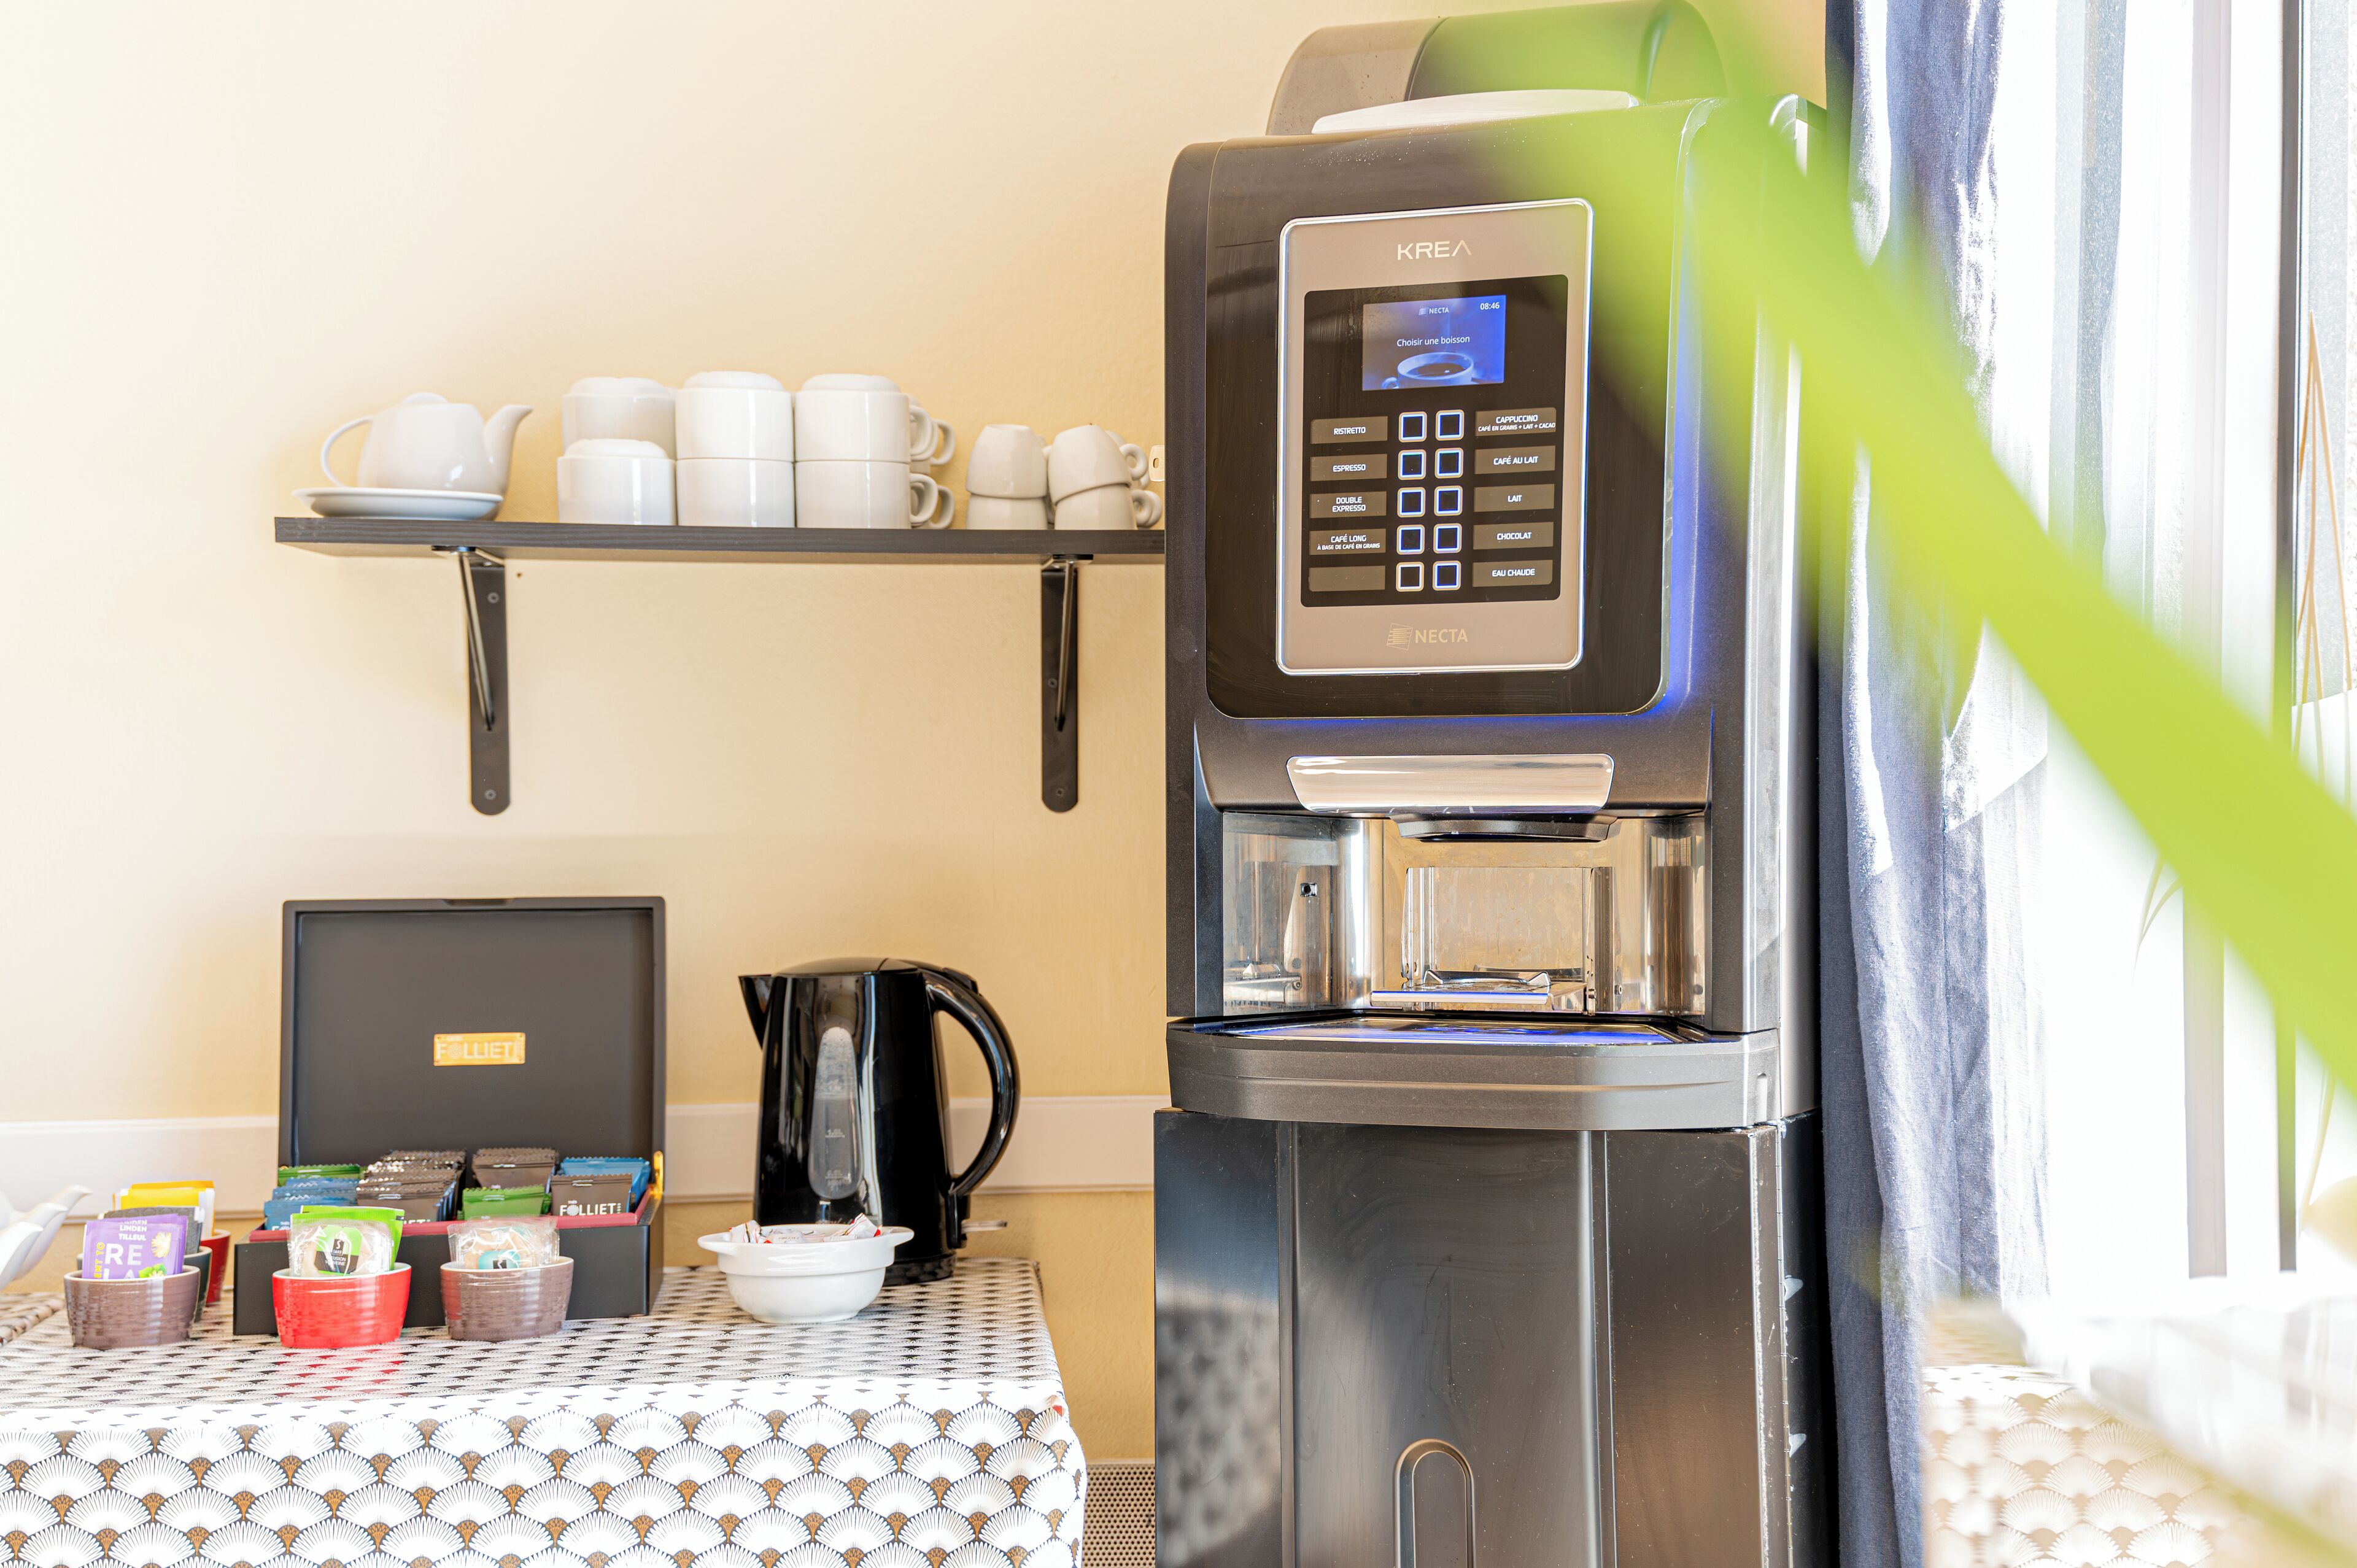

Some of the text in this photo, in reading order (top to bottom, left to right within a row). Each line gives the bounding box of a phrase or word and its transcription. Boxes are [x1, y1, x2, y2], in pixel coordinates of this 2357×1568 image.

[1397, 239, 1473, 261] KREA
[1480, 302, 1500, 311] 08:46
[1397, 338, 1423, 347] Choisir
[1496, 414, 1538, 424] CAPPUCCINO
[1333, 427, 1366, 435] RISTRETTO
[1493, 455, 1511, 465] CAFÉ
[1333, 464, 1366, 473] ESPRESSO
[1336, 496, 1362, 504] DOUBLE
[1332, 504, 1366, 512] EXPRESSO
[1331, 533, 1347, 543] CAFÉ
[1496, 531, 1532, 540] CHOCOLAT
[1492, 568, 1536, 577] EAU CHAUDE
[1415, 628, 1468, 644] NECTA
[96, 1242, 105, 1256] TO
[105, 1243, 143, 1265] RE
